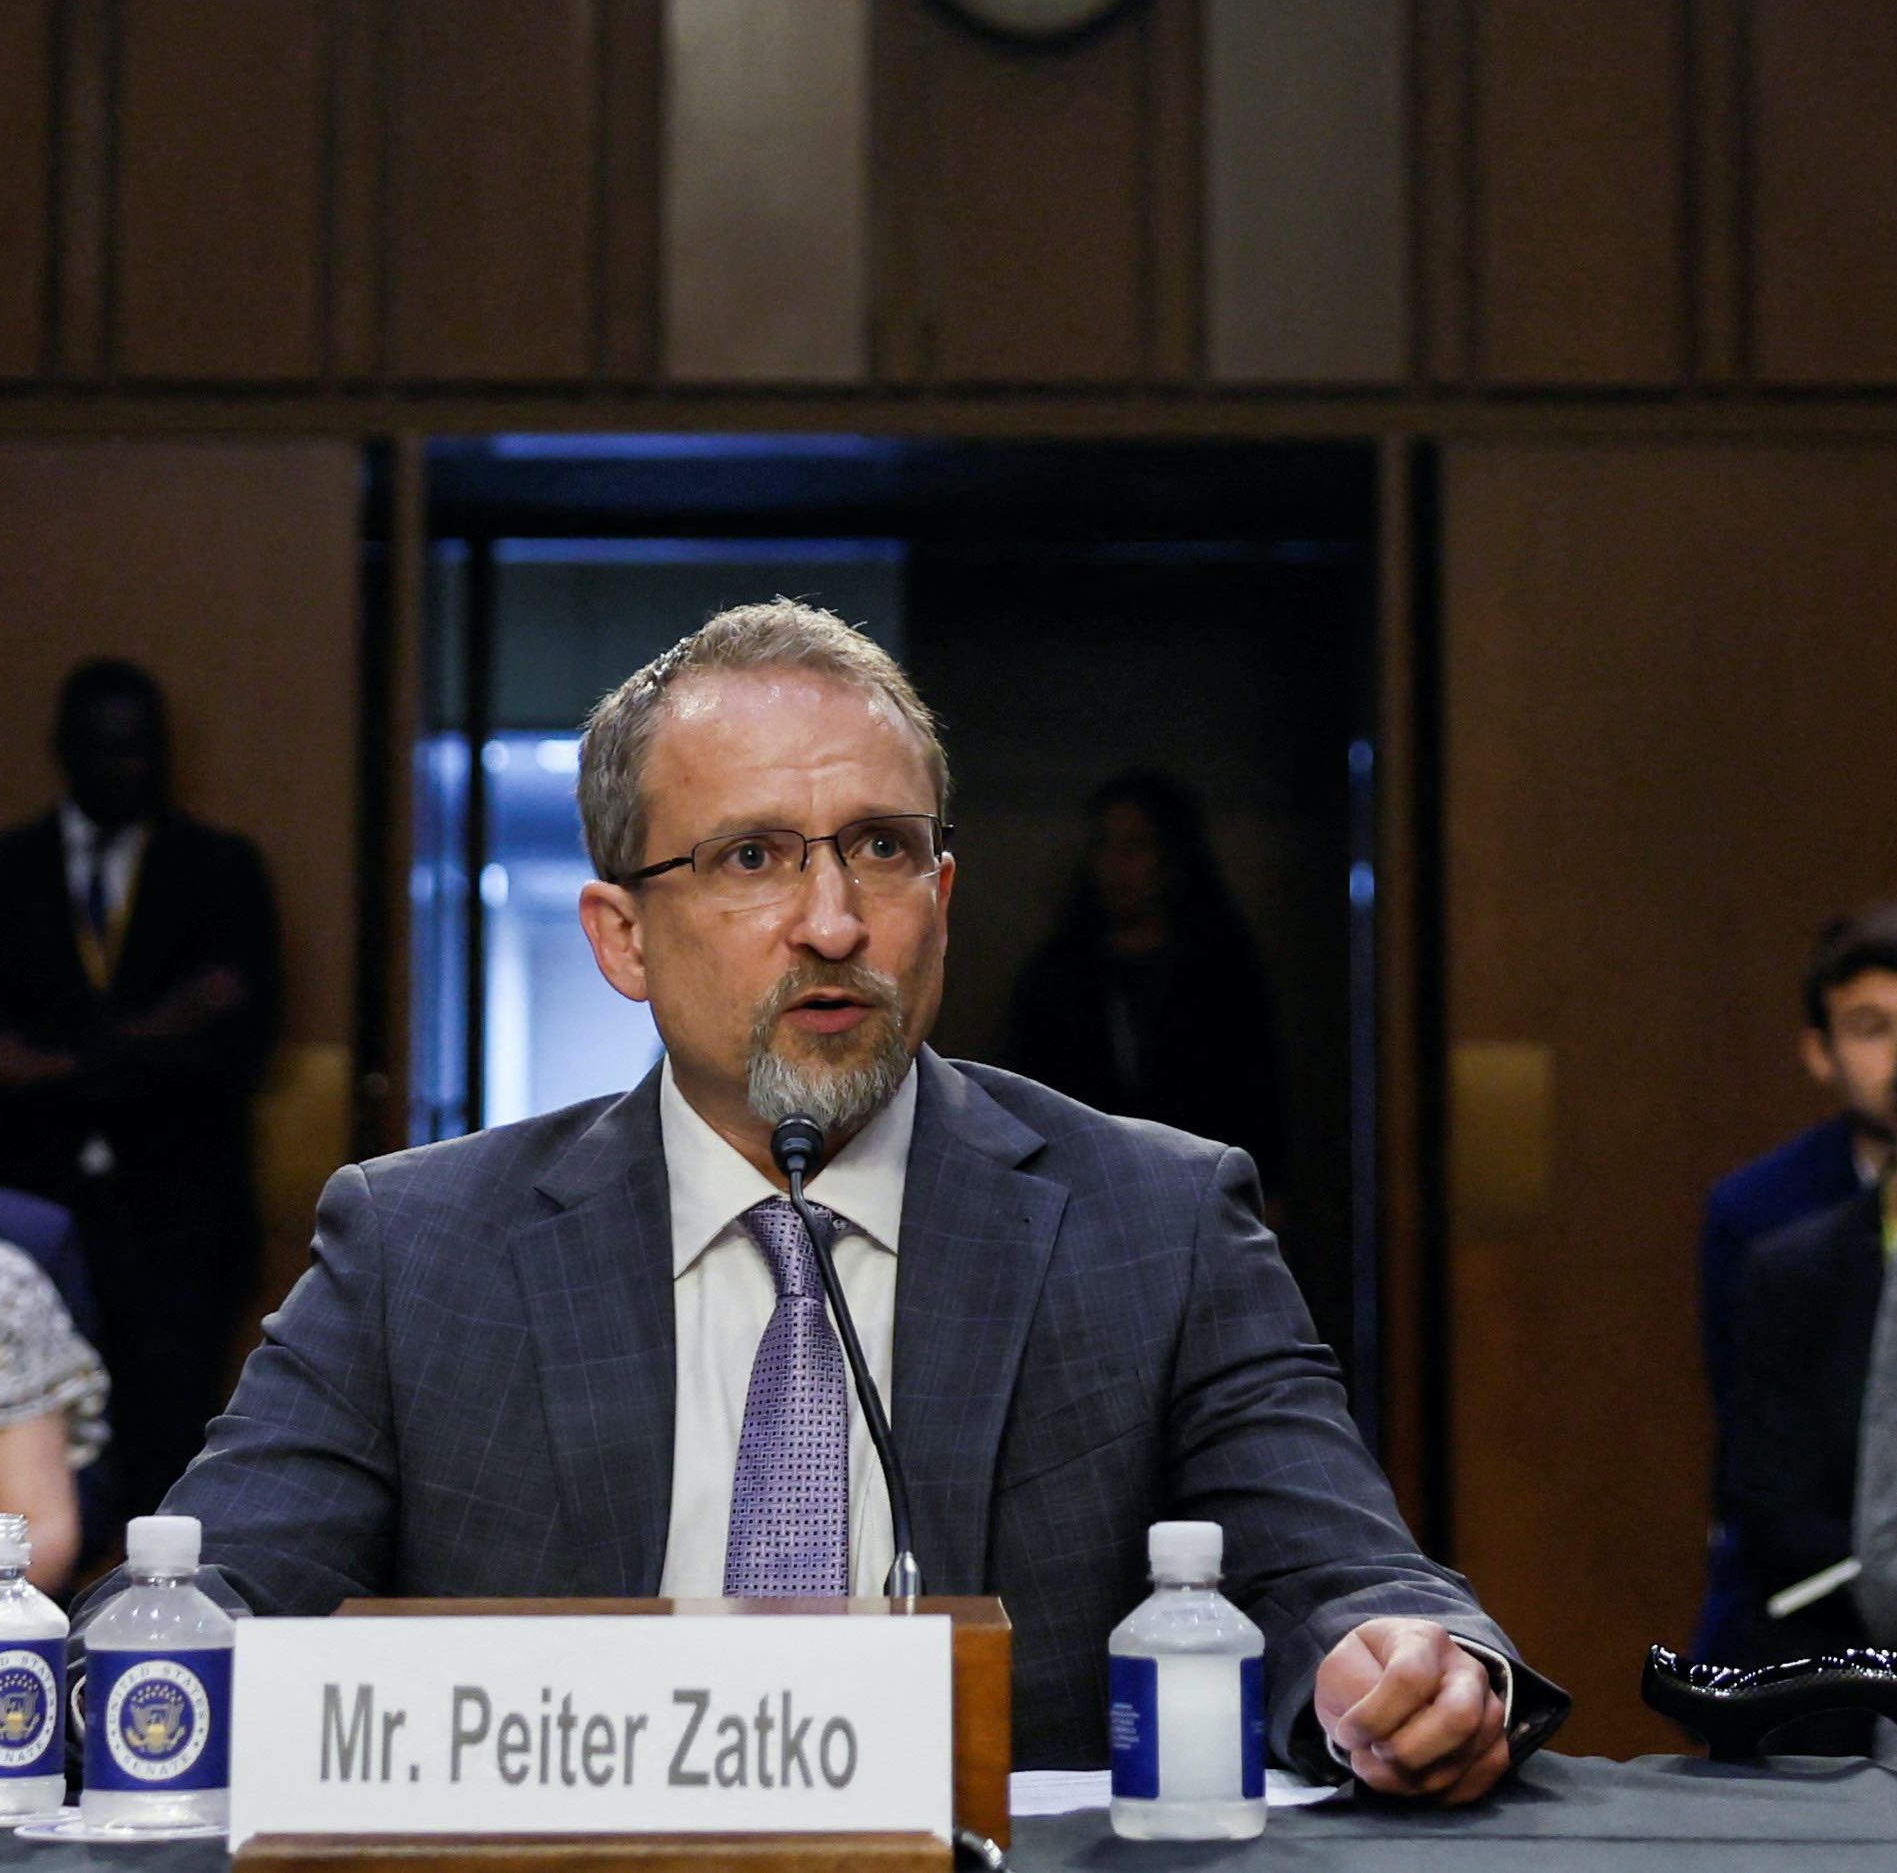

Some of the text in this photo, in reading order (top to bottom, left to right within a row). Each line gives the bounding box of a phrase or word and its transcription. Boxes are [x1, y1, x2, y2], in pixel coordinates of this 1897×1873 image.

[319, 1683, 858, 1790] Mr. Peiter Zatko
